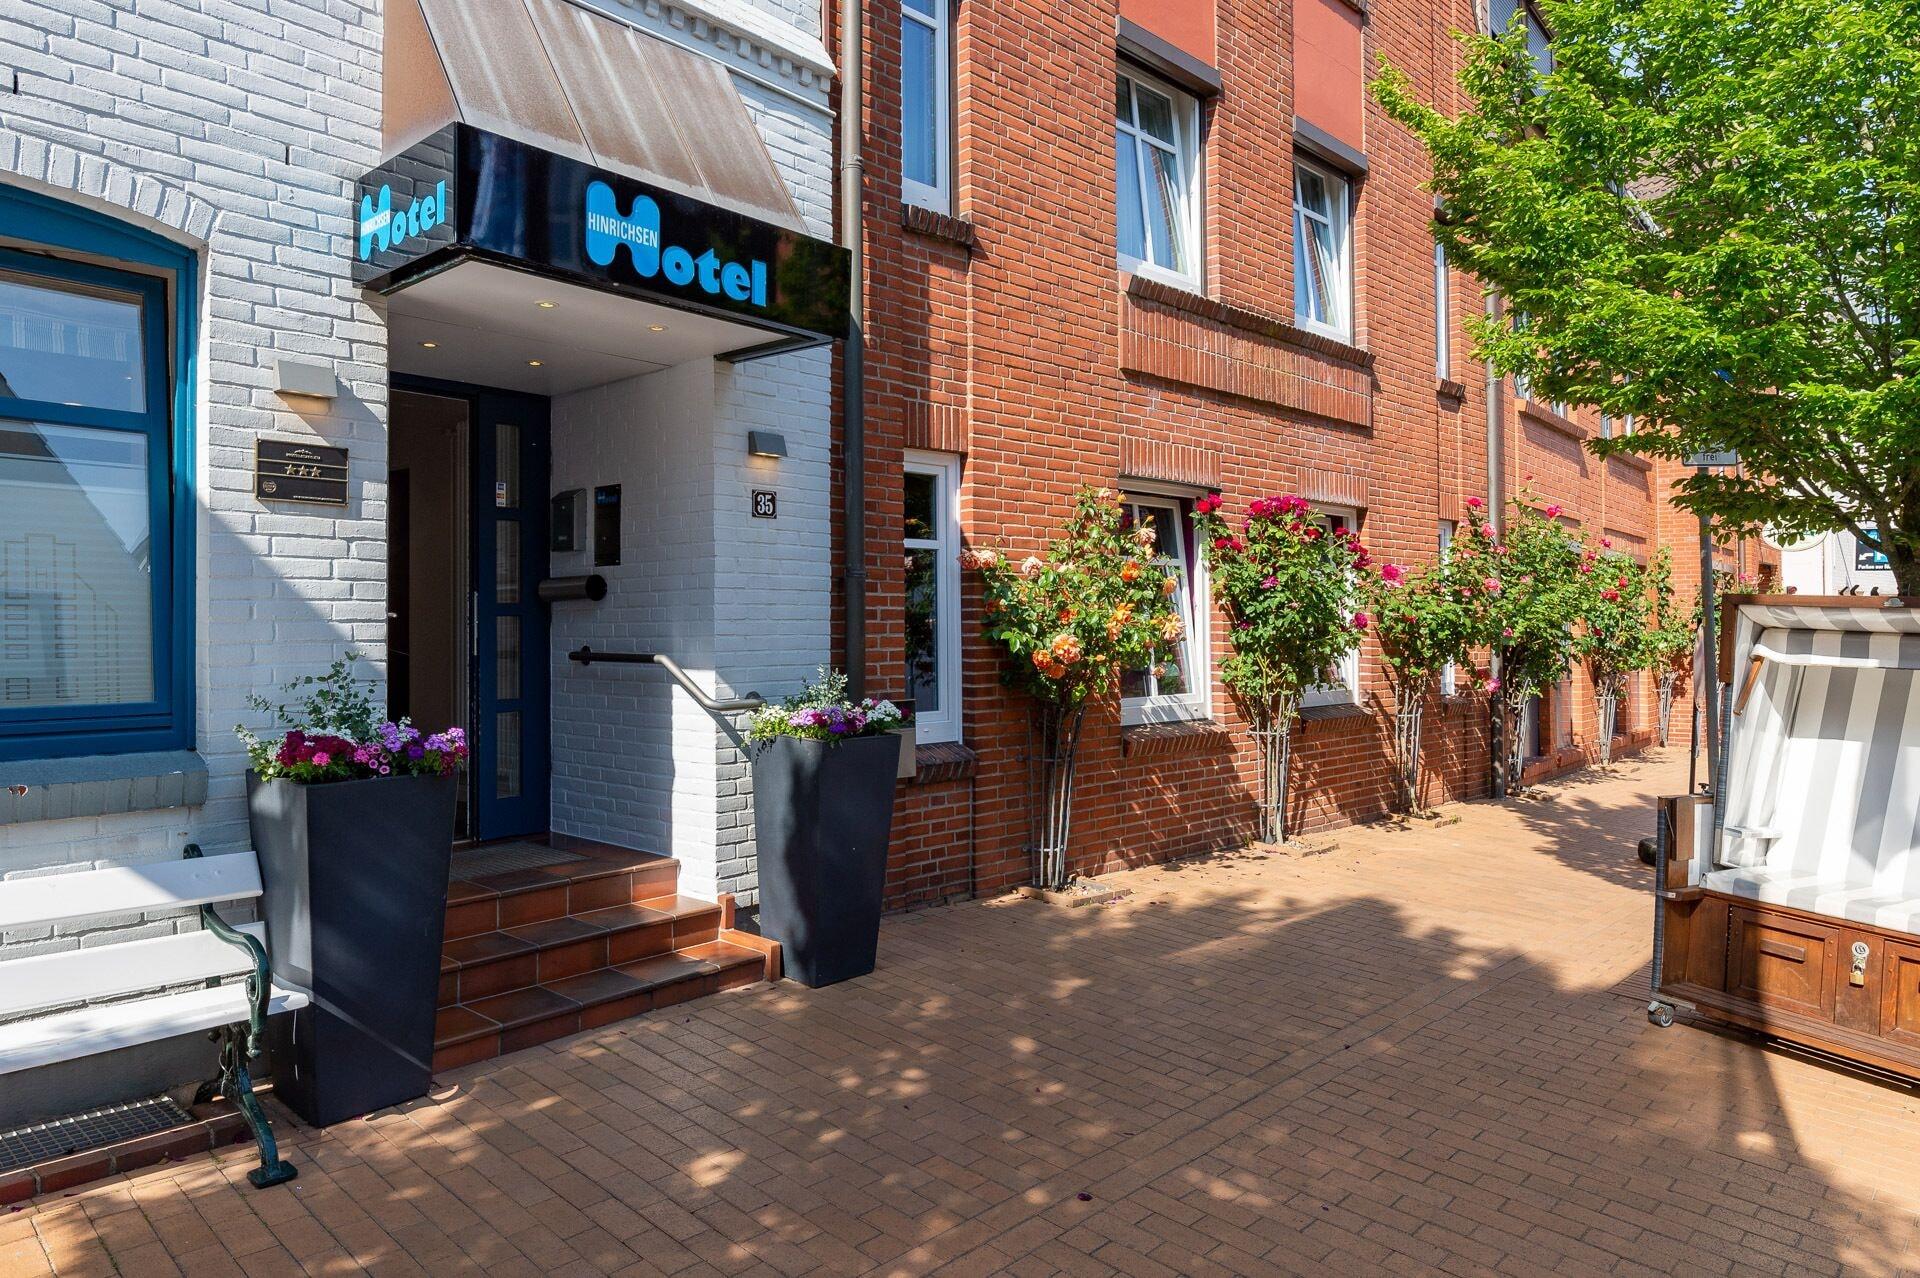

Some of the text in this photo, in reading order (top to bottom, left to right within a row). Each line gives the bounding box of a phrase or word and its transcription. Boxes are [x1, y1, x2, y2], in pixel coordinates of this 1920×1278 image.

[361, 180, 445, 261] Hotel
[588, 211, 658, 249] HINRICHSEN
[586, 180, 767, 307] Hotel
[1703, 452, 1718, 461] frei
[757, 494, 774, 515] 35
